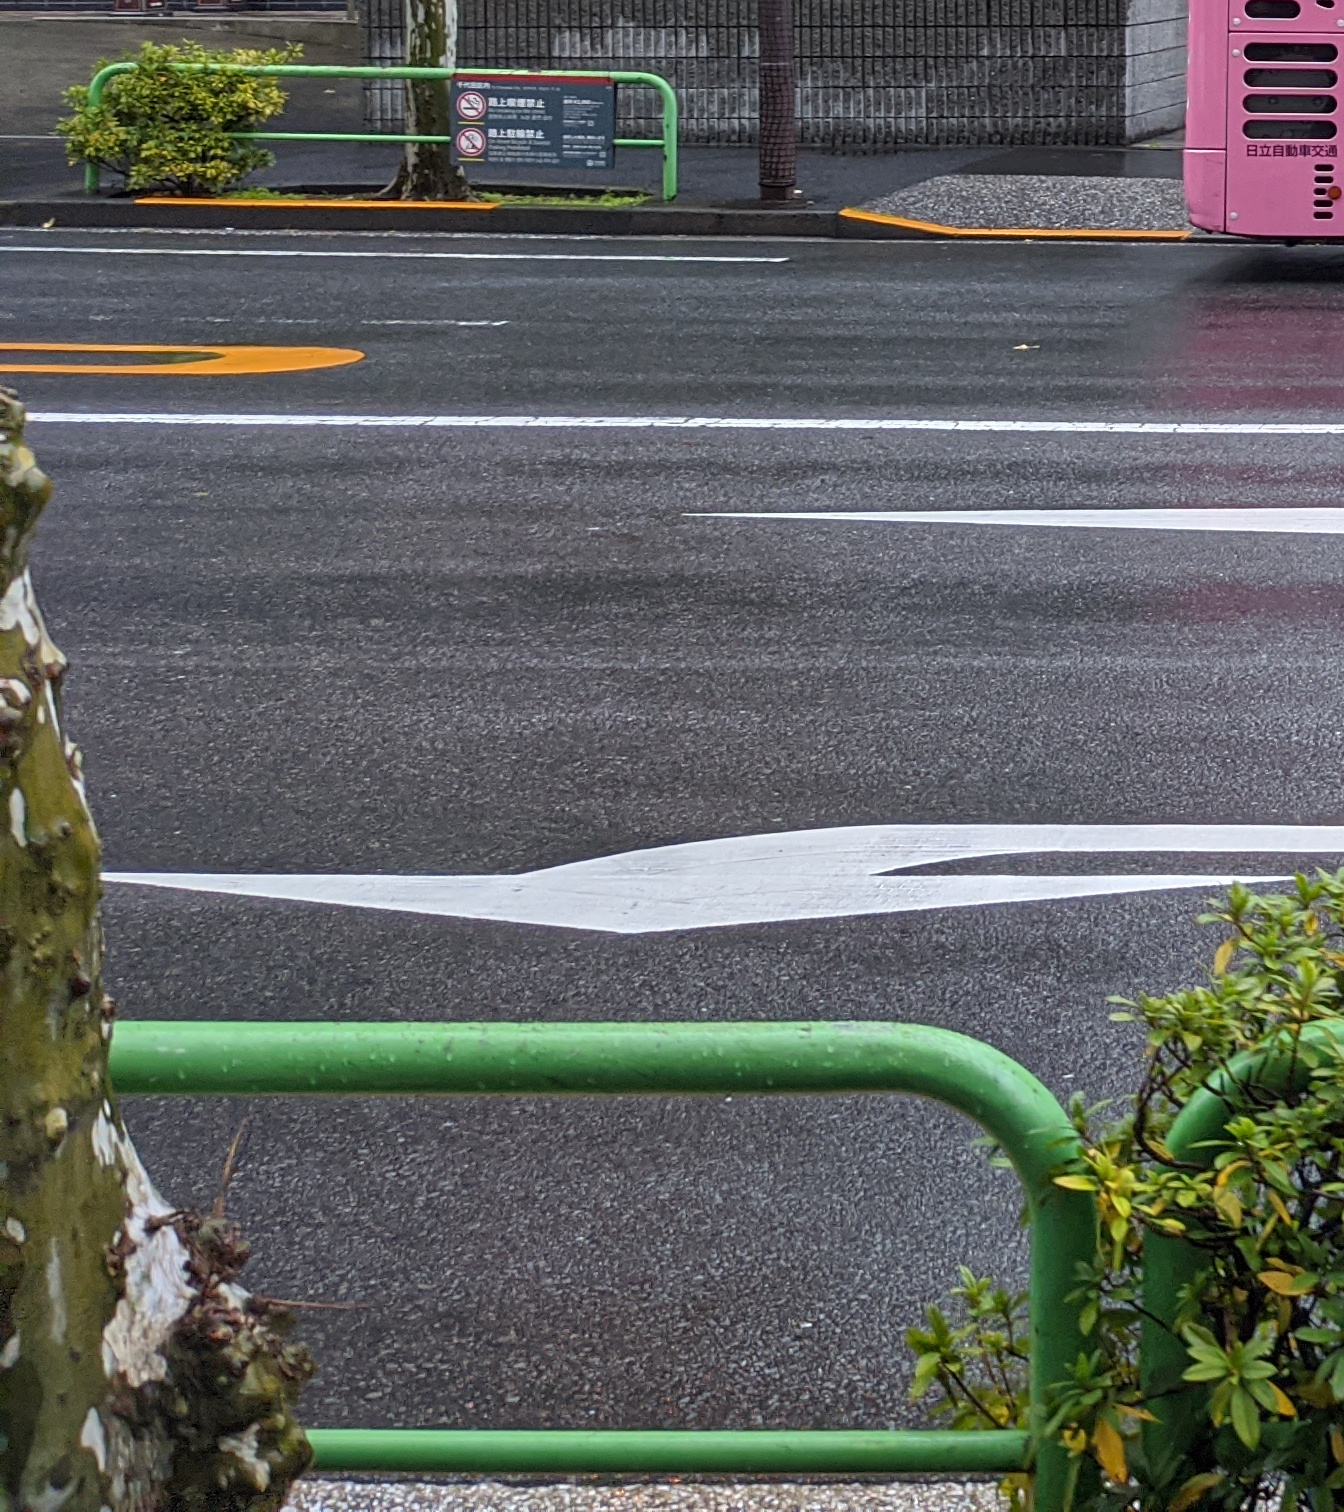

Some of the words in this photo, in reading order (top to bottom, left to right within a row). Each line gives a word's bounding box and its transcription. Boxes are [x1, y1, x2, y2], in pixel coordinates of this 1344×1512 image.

[1246, 144, 1338, 158] 日立自動車交通
